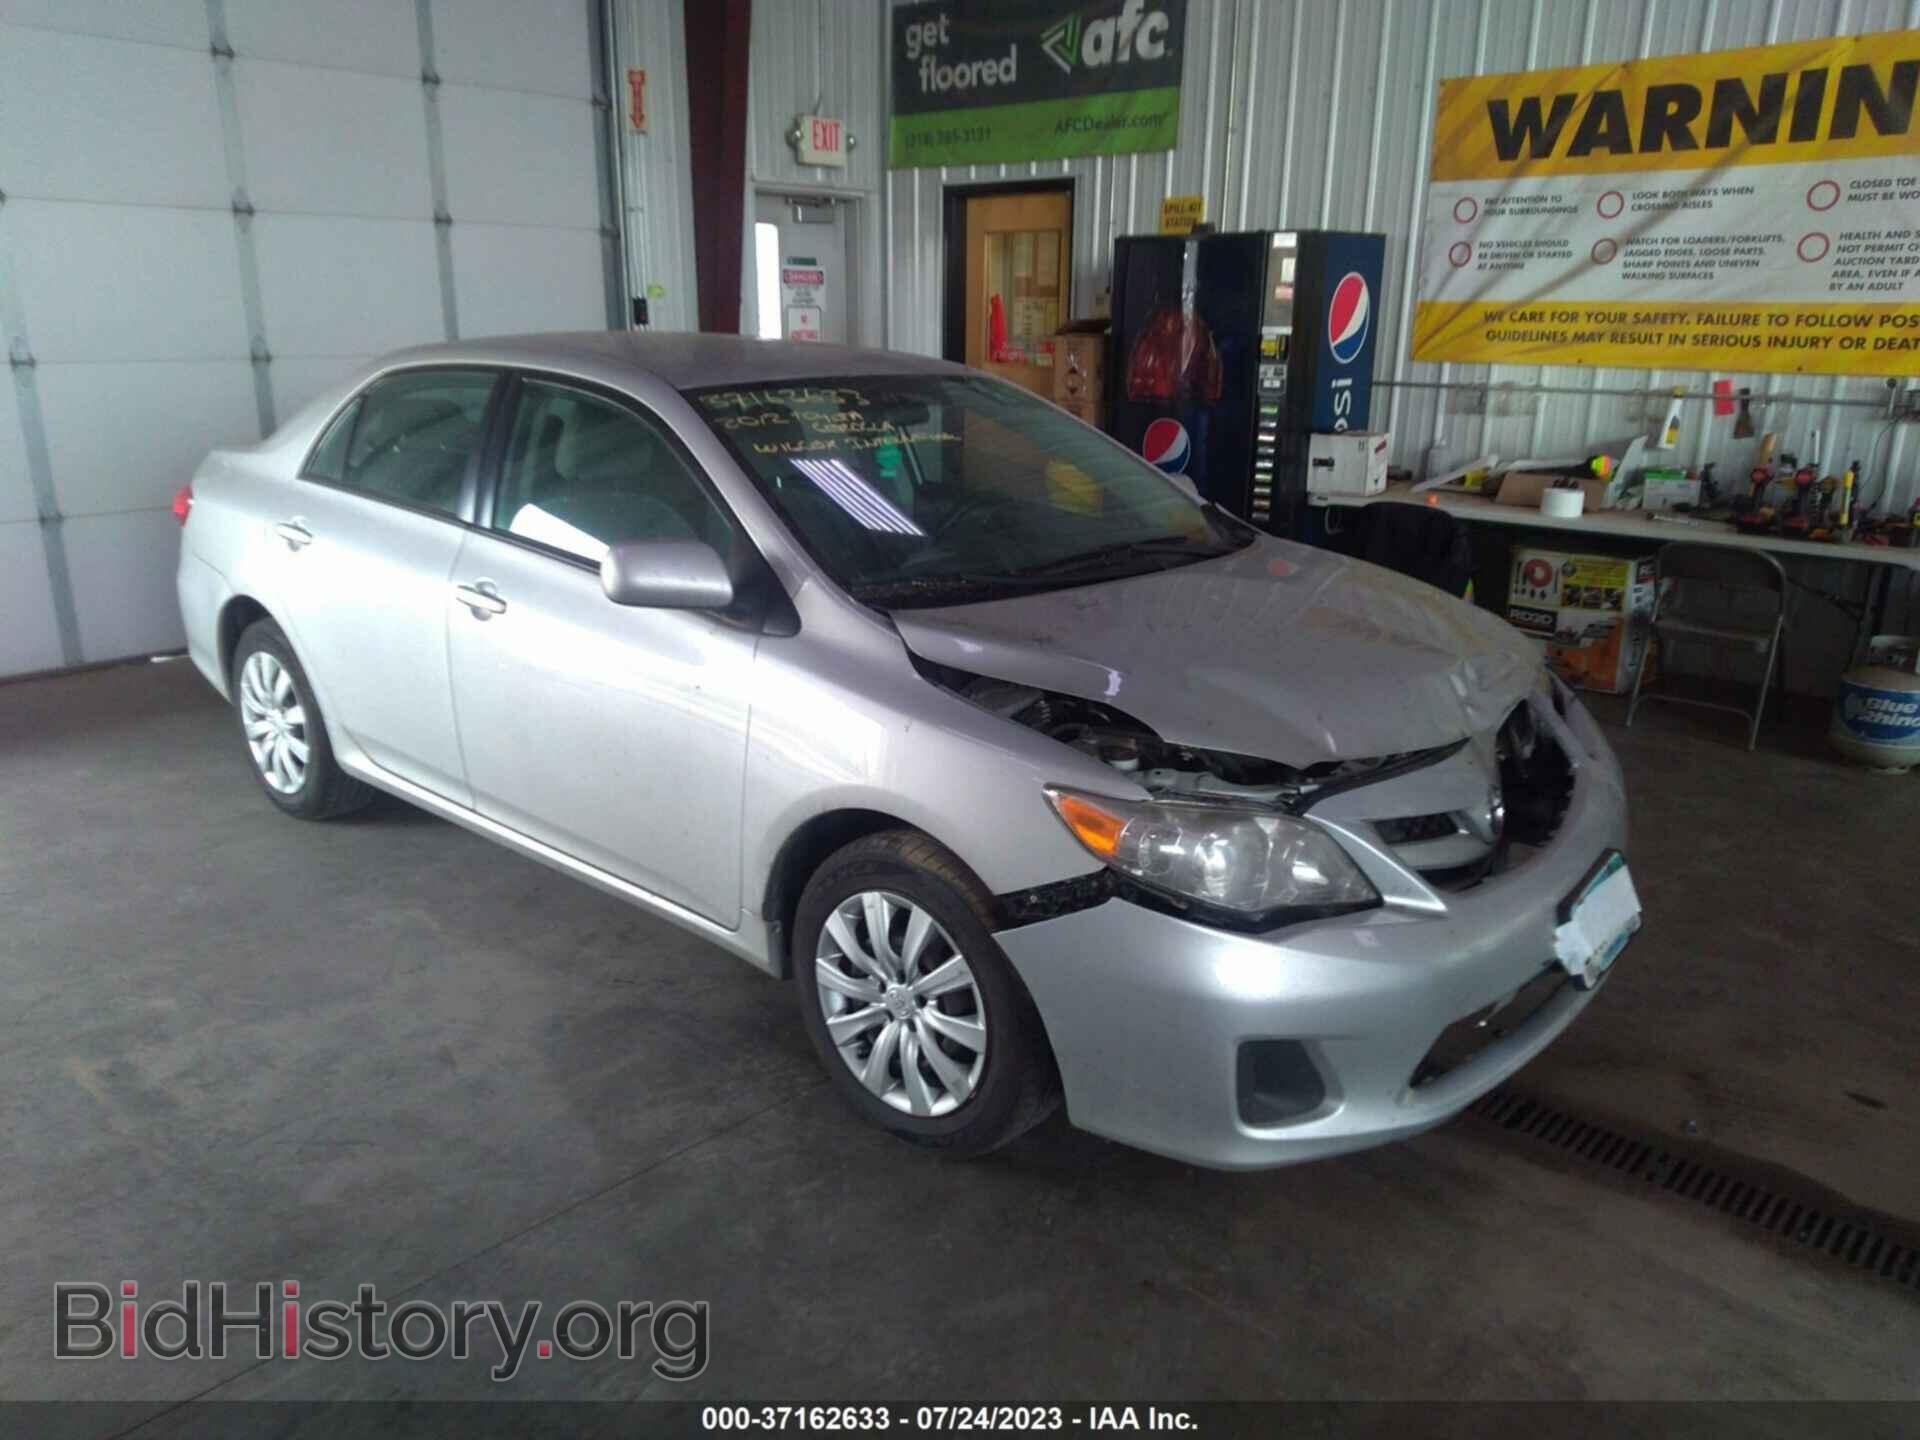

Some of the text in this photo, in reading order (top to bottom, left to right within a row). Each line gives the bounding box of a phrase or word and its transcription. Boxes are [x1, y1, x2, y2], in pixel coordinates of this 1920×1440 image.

[906, 14, 949, 58] get
[1082, 0, 1169, 67] afc
[919, 44, 1017, 92] floored
[1487, 60, 1920, 162] WARNIN
[812, 119, 840, 152] EXIT
[1849, 177, 1917, 189] CLOSED TOE
[1632, 191, 1659, 200] LOOK
[1721, 186, 1754, 196] WHEN
[1848, 192, 1881, 202] MUST
[1882, 191, 1895, 201] BE
[1501, 195, 1548, 205] ATTENTION
[1551, 194, 1562, 203] TO
[1508, 205, 1578, 216] SURROUNDINGS
[1631, 200, 1713, 212] CROSSING AISLES
[1625, 236, 1658, 246] WATCH
[1660, 236, 1680, 245] FOR
[1839, 231, 1881, 241] HEALTH
[1884, 230, 1911, 239] AND
[1479, 240, 1493, 249] NO
[1534, 239, 1569, 248] SHOULD
[1837, 244, 1861, 254] NOT
[1863, 243, 1905, 253] PERMIT
[1537, 250, 1573, 259] STARTED
[1624, 248, 1661, 258] JAGGED
[1699, 247, 1730, 257] LOOSE
[1622, 259, 1760, 270] SHARP POINTS AND UNEVEN
[1833, 255, 1920, 266] AUCTION YARD
[1621, 271, 1714, 281] WALKING SURFACES
[1867, 269, 1898, 279] EVEN
[1900, 268, 1911, 278] IF
[1829, 281, 1904, 292] BY AN ADULT
[1484, 310, 1505, 323] WE
[1509, 310, 1545, 323] CARE
[1550, 310, 1580, 323] FOR
[1584, 310, 1628, 324] YOUR
[1631, 311, 1691, 326] SAFETY.
[1696, 312, 1761, 327] FAILURE
[1767, 313, 1790, 327] TO
[1795, 313, 1874, 328] FOLLOW
[1485, 329, 1568, 344] GUIDELINES
[1571, 330, 1604, 344] MAY
[1609, 331, 1664, 345] RESULT
[1667, 332, 1686, 346] IN
[1691, 333, 1761, 348] SERIOUS
[1767, 335, 1833, 350] INJURY
[1838, 336, 1866, 351] OR
[715, 412, 789, 430] 2012
[1865, 697, 1919, 714] Blue
